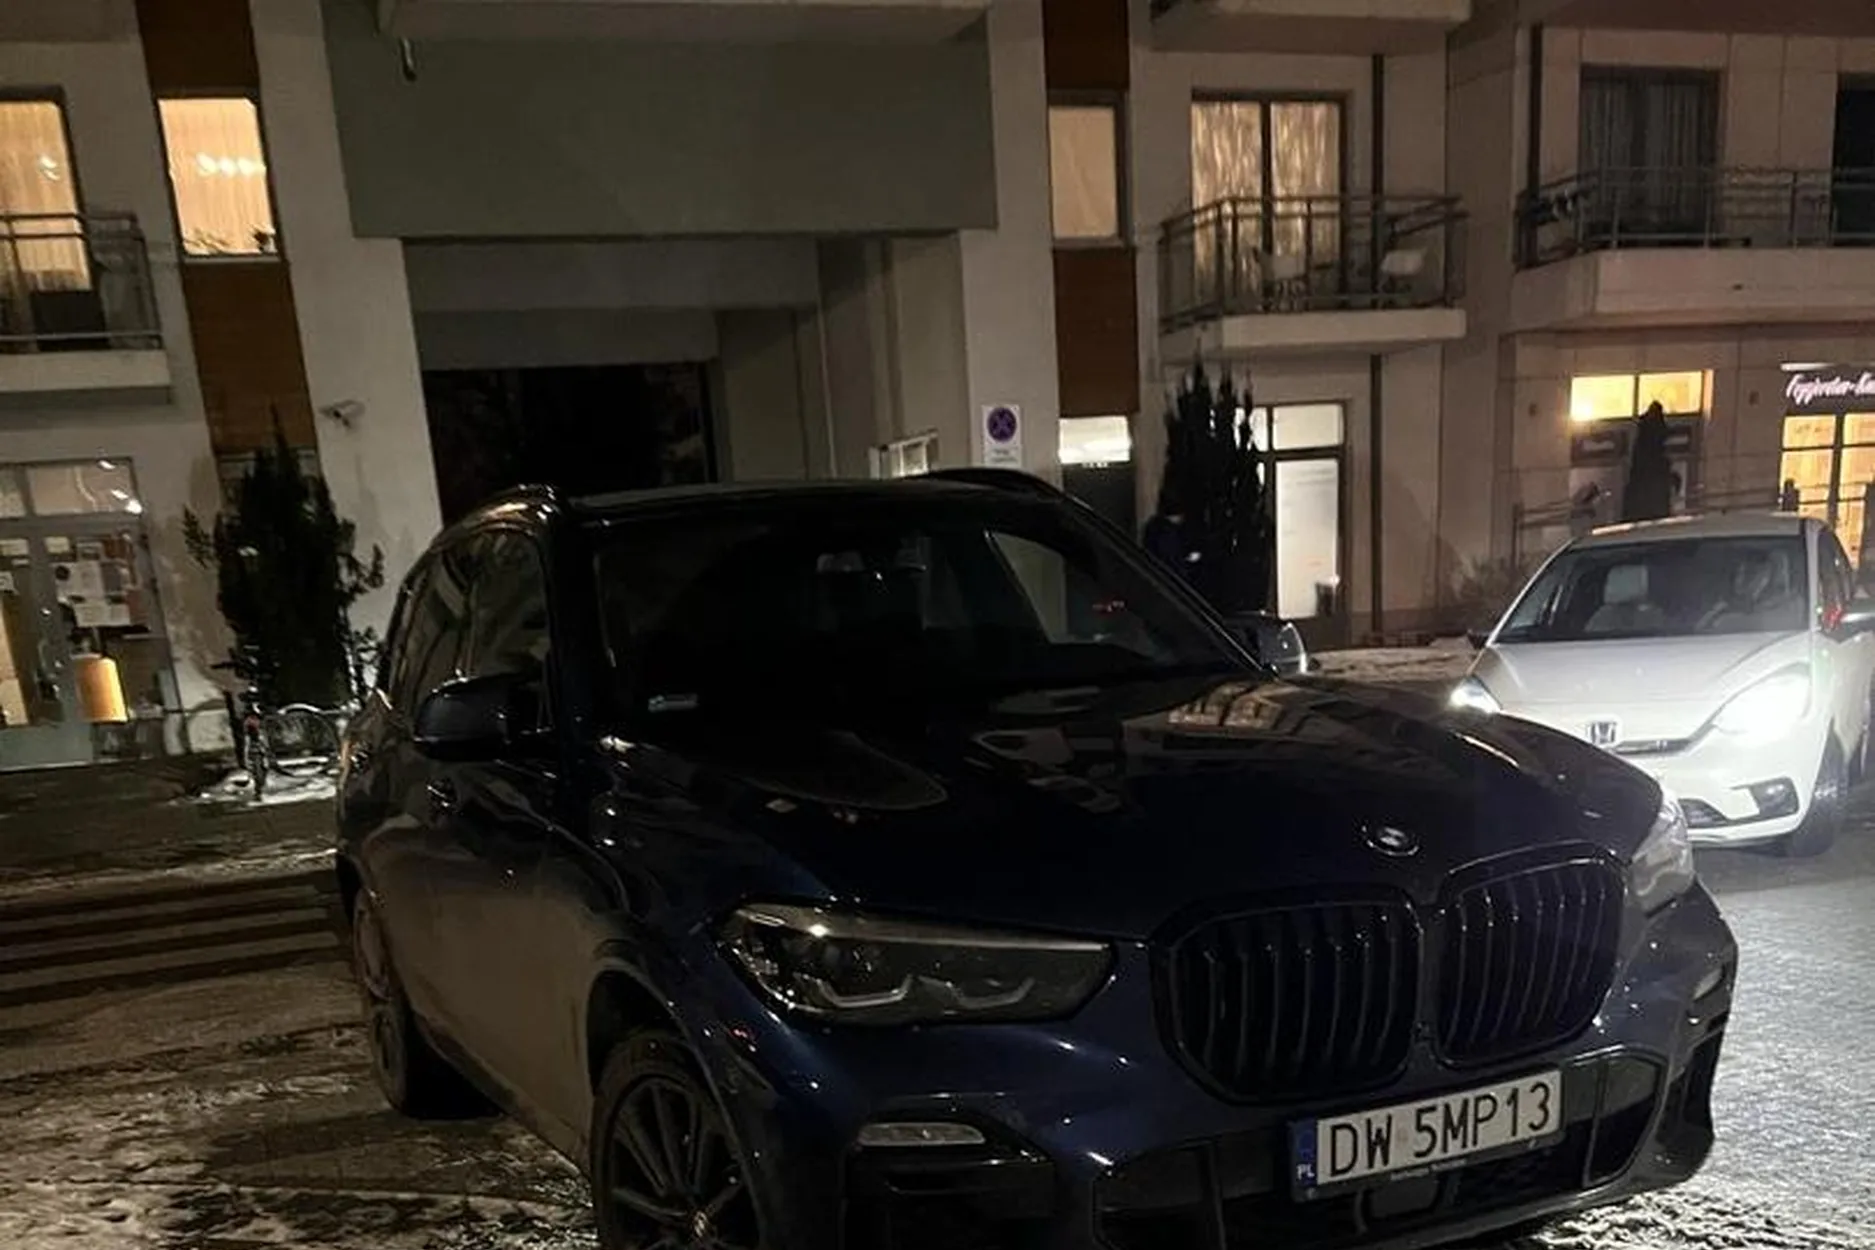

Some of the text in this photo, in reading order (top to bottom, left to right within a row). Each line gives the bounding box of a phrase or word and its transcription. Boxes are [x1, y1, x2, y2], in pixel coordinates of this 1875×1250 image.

[1330, 1081, 1550, 1178] DW 5MP13
[1297, 1164, 1315, 1179] PL
